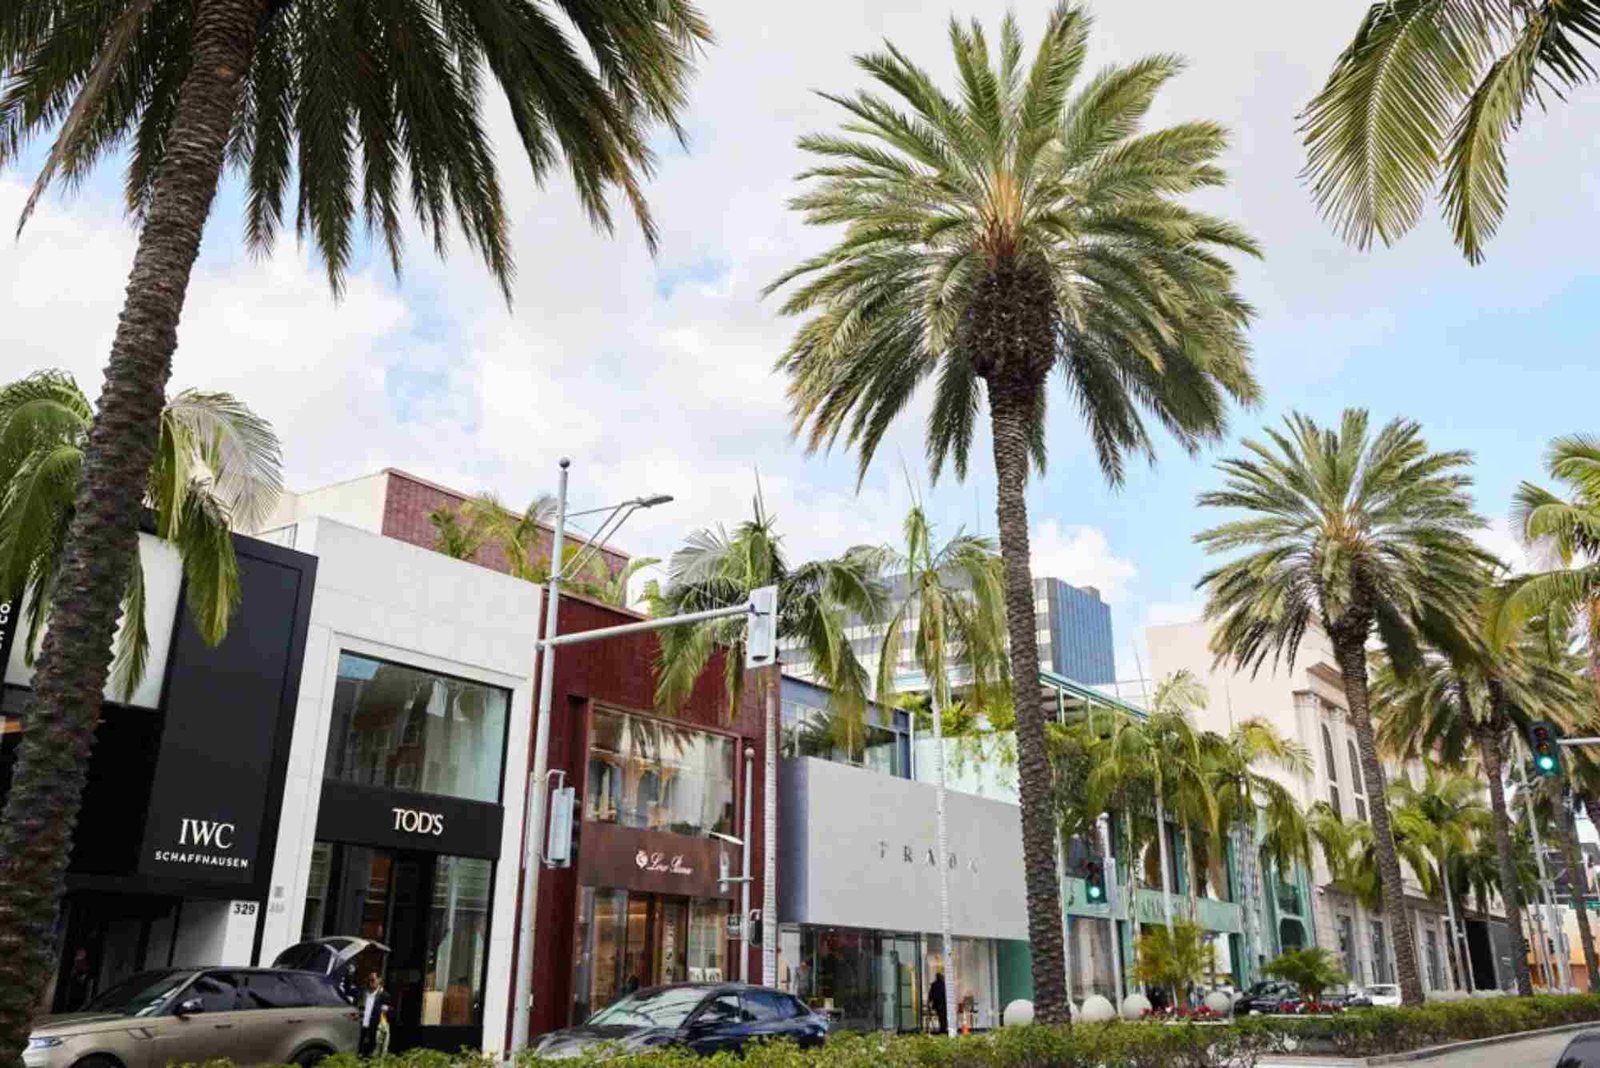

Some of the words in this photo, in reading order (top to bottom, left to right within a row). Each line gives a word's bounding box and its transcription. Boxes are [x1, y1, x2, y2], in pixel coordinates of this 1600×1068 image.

[178, 818, 235, 849] IWC
[392, 808, 444, 836] TOD'S
[154, 850, 249, 868] SCHAFFHAUSEN
[233, 903, 256, 915] 329
